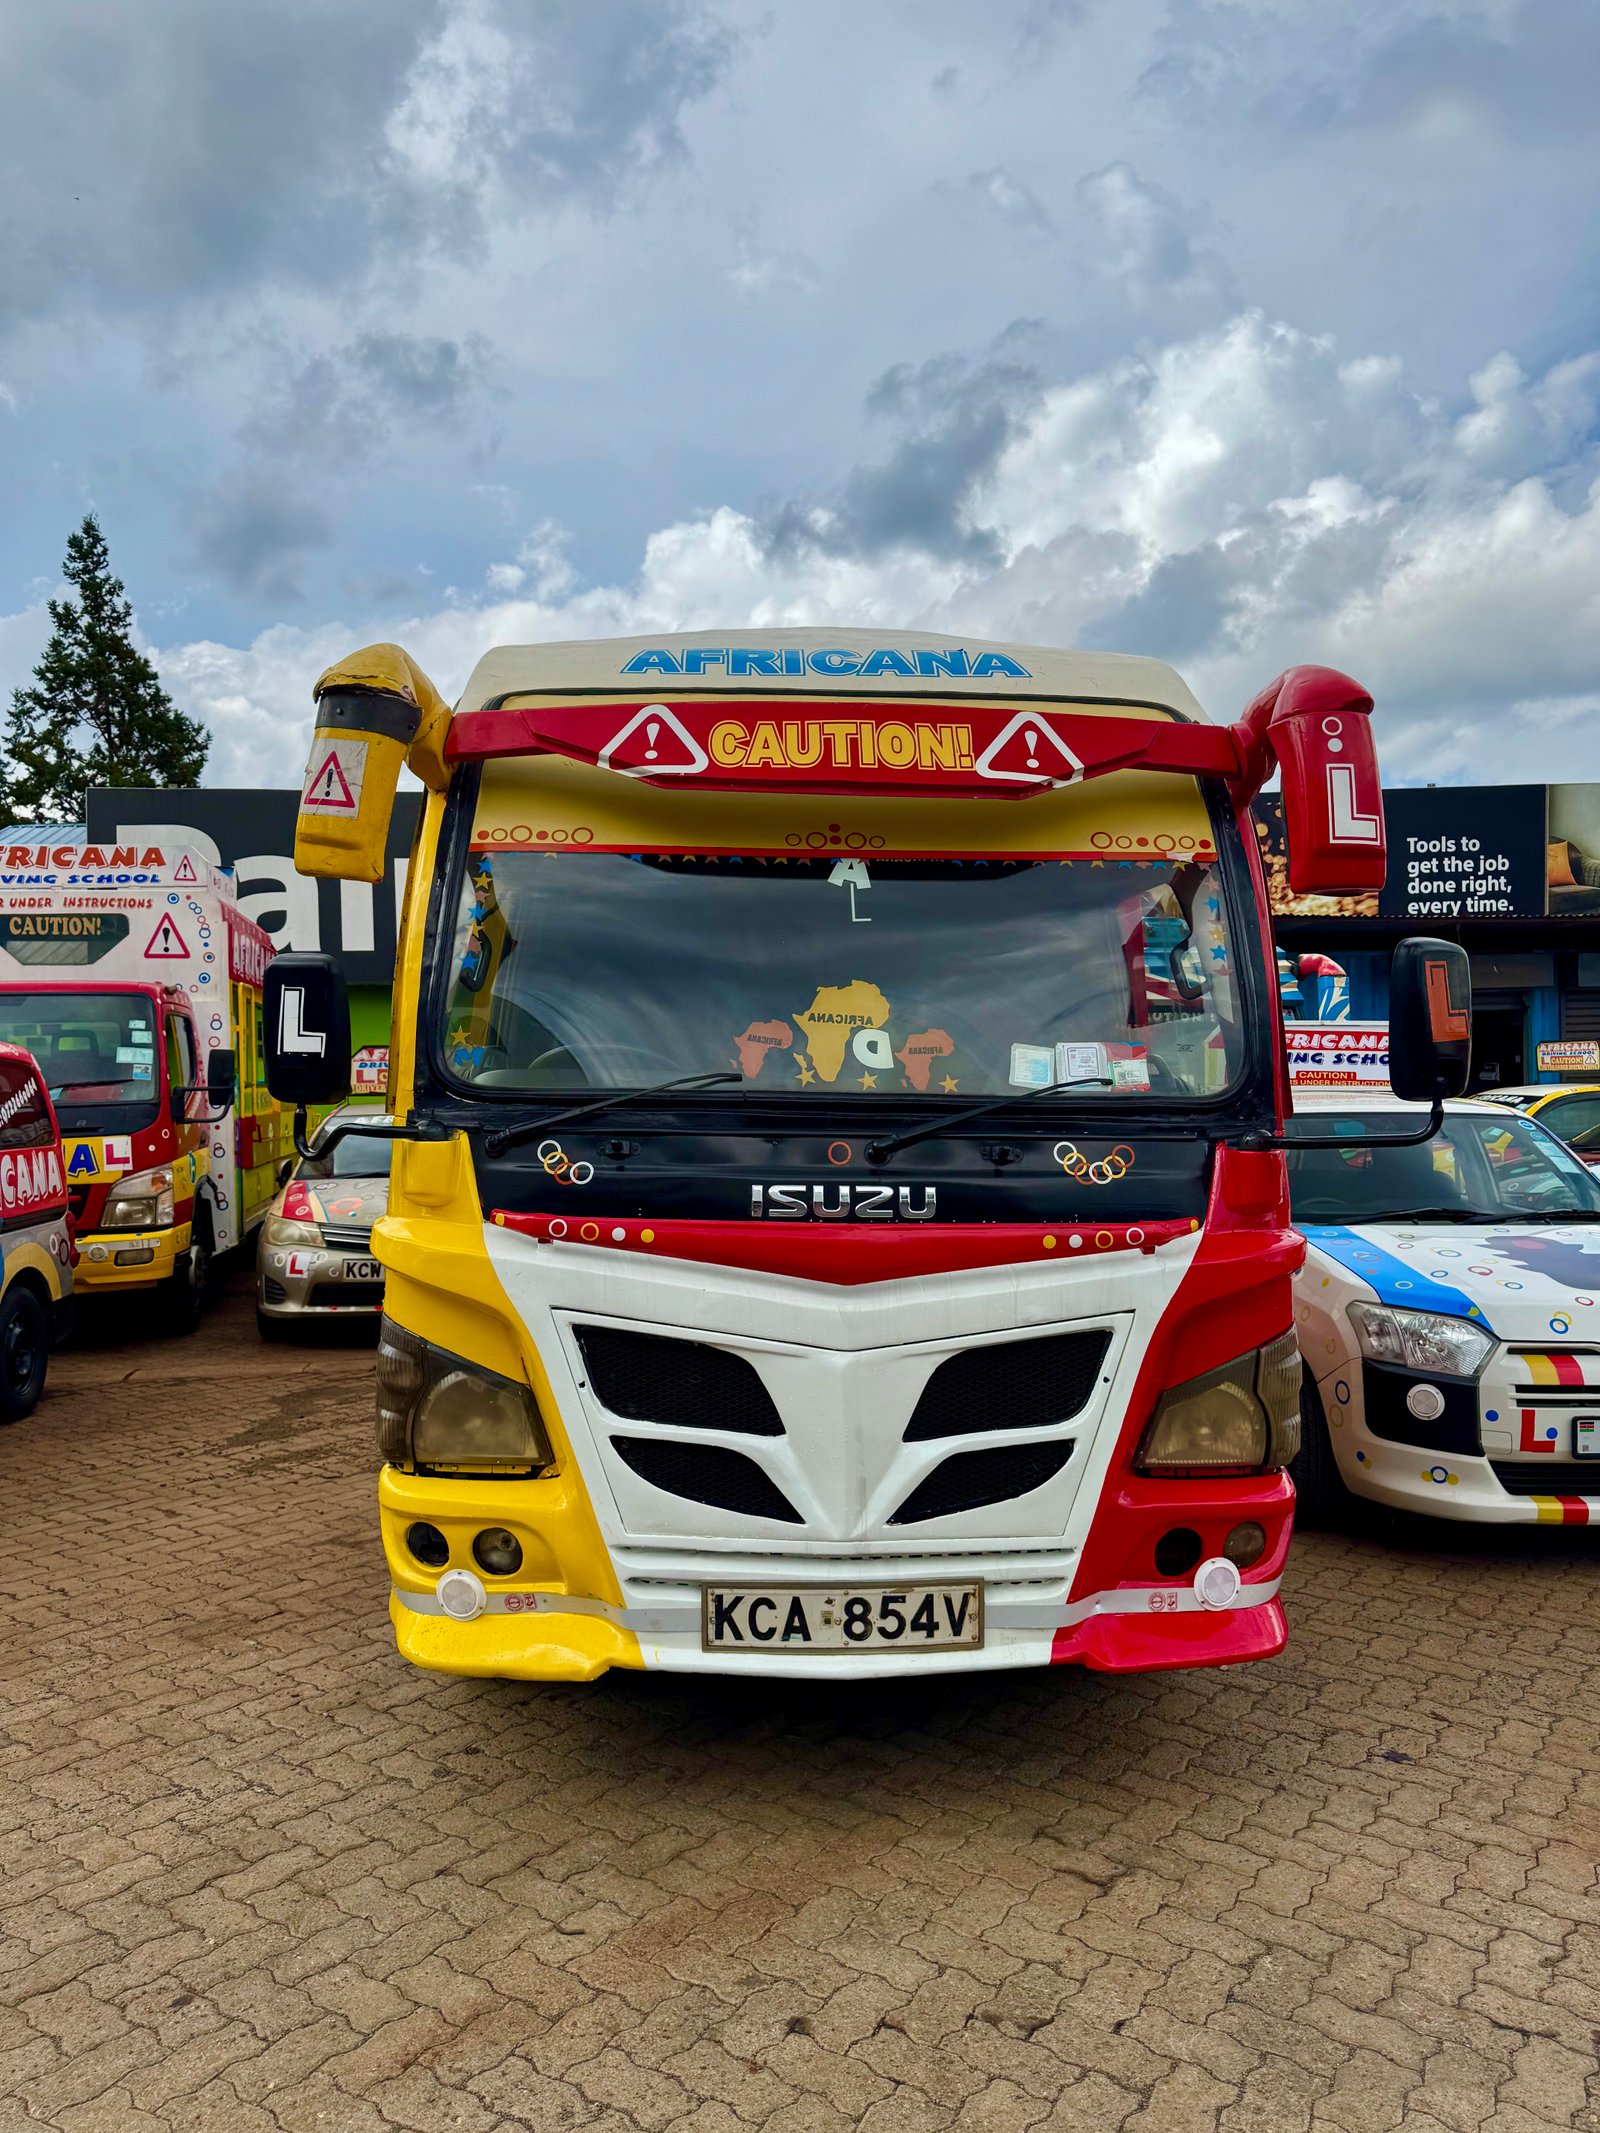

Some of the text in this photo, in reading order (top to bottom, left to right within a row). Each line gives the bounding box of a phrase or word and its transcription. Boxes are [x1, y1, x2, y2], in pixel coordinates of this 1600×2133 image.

[619, 648, 1033, 678] AFRICANA
[708, 719, 976, 771] CAUTION!
[1326, 763, 1382, 847] L
[1406, 835, 1481, 854] Tools to
[1407, 854, 1510, 878] get the job
[67, 873, 161, 885] SCHOOL
[1407, 875, 1512, 896] done right,
[9, 897, 53, 909] UNDER
[63, 896, 154, 910] INSTRUCTIONS
[1407, 896, 1514, 917] every time.
[9, 916, 102, 936] CAUTION!
[1424, 960, 1470, 1043] L
[276, 984, 327, 1059] L
[1299, 1071, 1348, 1080] CAUTION
[1300, 1079, 1331, 1087] UNDER
[105, 1143, 130, 1166] L
[751, 1184, 937, 1219] ISUZU
[345, 1262, 382, 1279] KCW
[1520, 1408, 1556, 1453] L
[713, 1592, 972, 1642] KCA 854V
